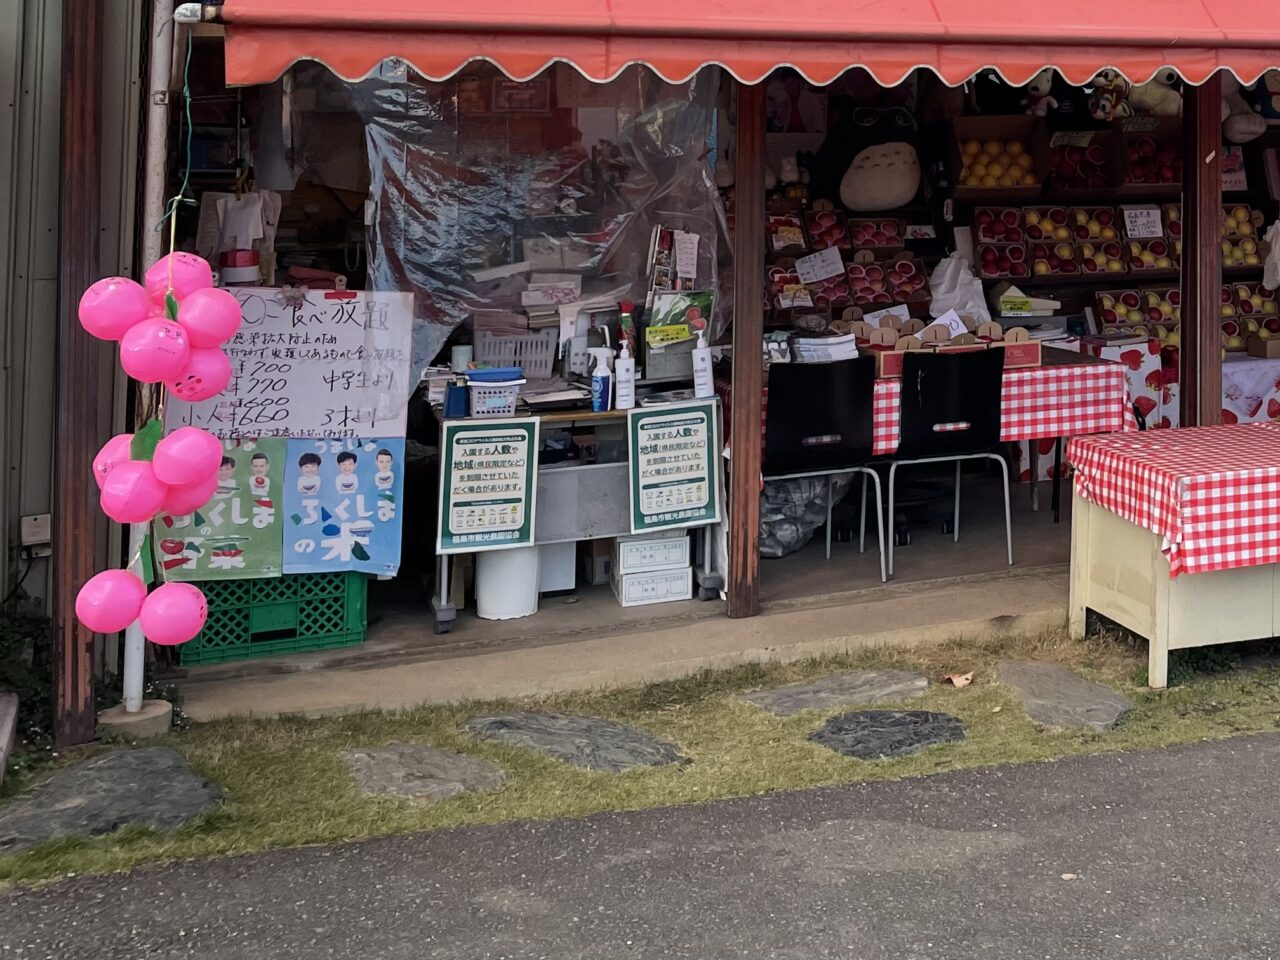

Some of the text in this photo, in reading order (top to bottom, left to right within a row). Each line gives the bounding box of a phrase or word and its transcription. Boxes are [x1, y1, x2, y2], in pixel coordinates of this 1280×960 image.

[226, 332, 337, 346] 感染拡大防止のため
[322, 369, 394, 392] 中学生より
[290, 490, 396, 526] ふくしま
